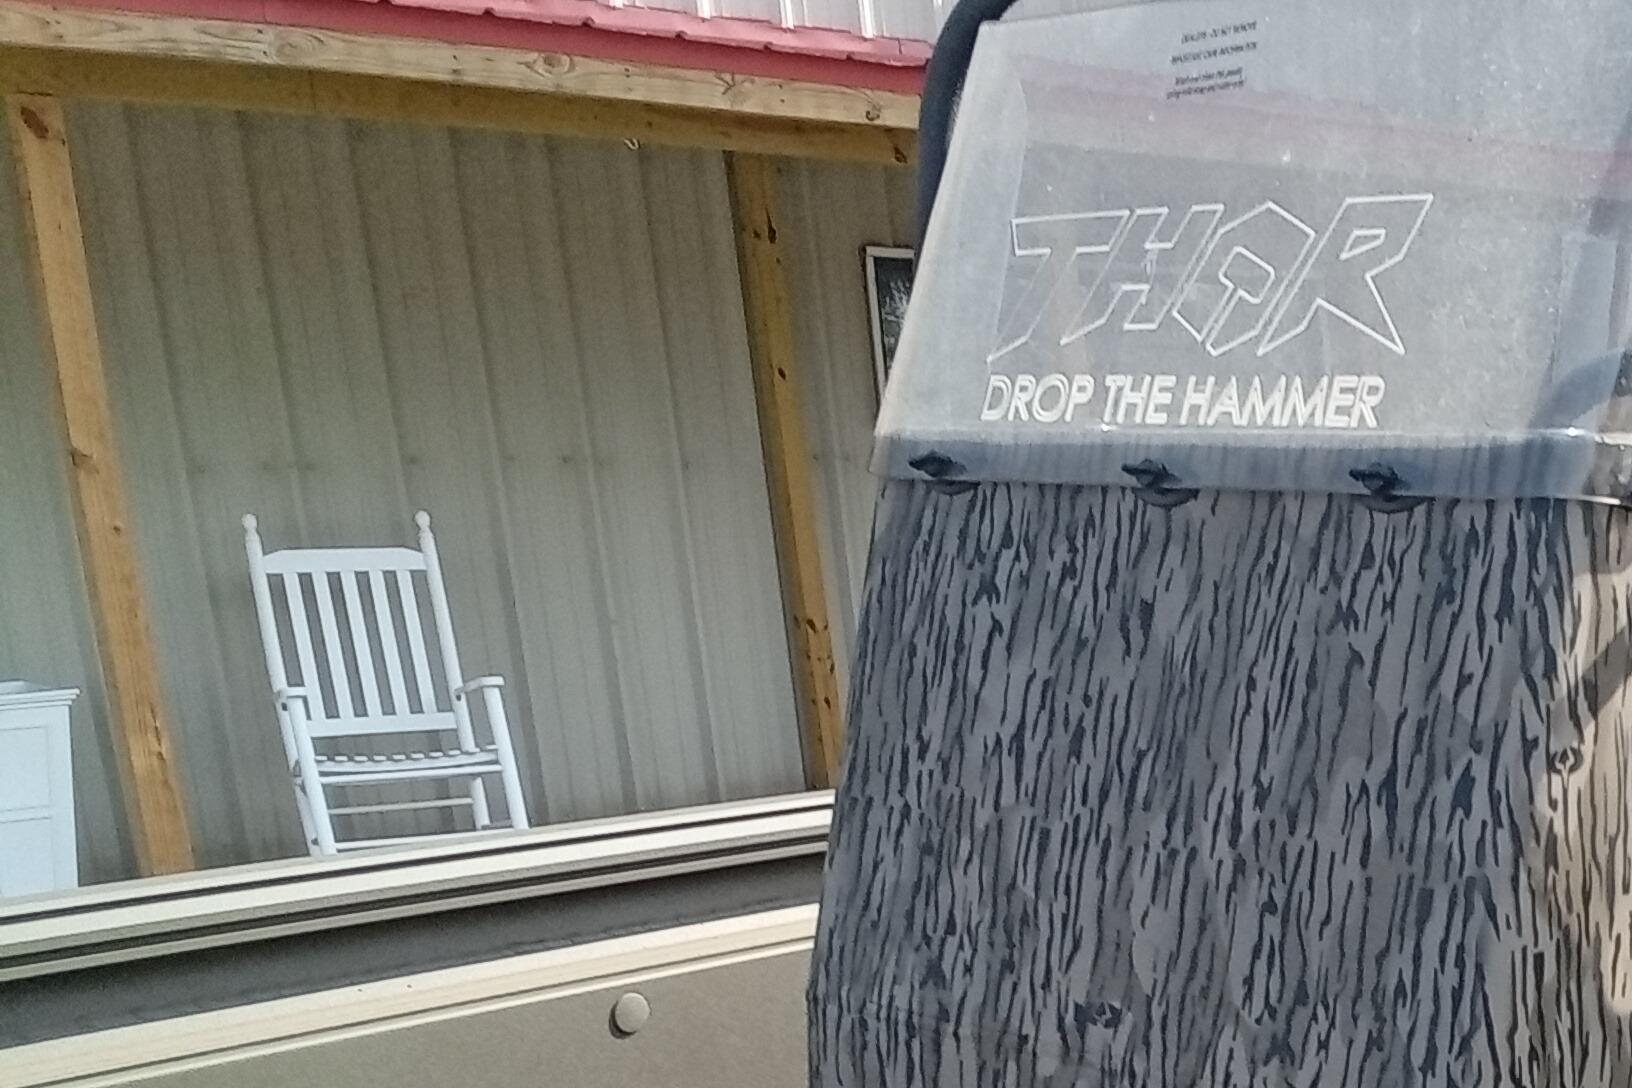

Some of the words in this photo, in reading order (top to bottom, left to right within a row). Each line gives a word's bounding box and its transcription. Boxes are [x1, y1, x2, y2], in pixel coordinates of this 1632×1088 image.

[985, 193, 1434, 363] THOR
[980, 373, 1095, 423] DROP
[1102, 373, 1178, 425] THE
[1179, 374, 1386, 428] HAMMER
